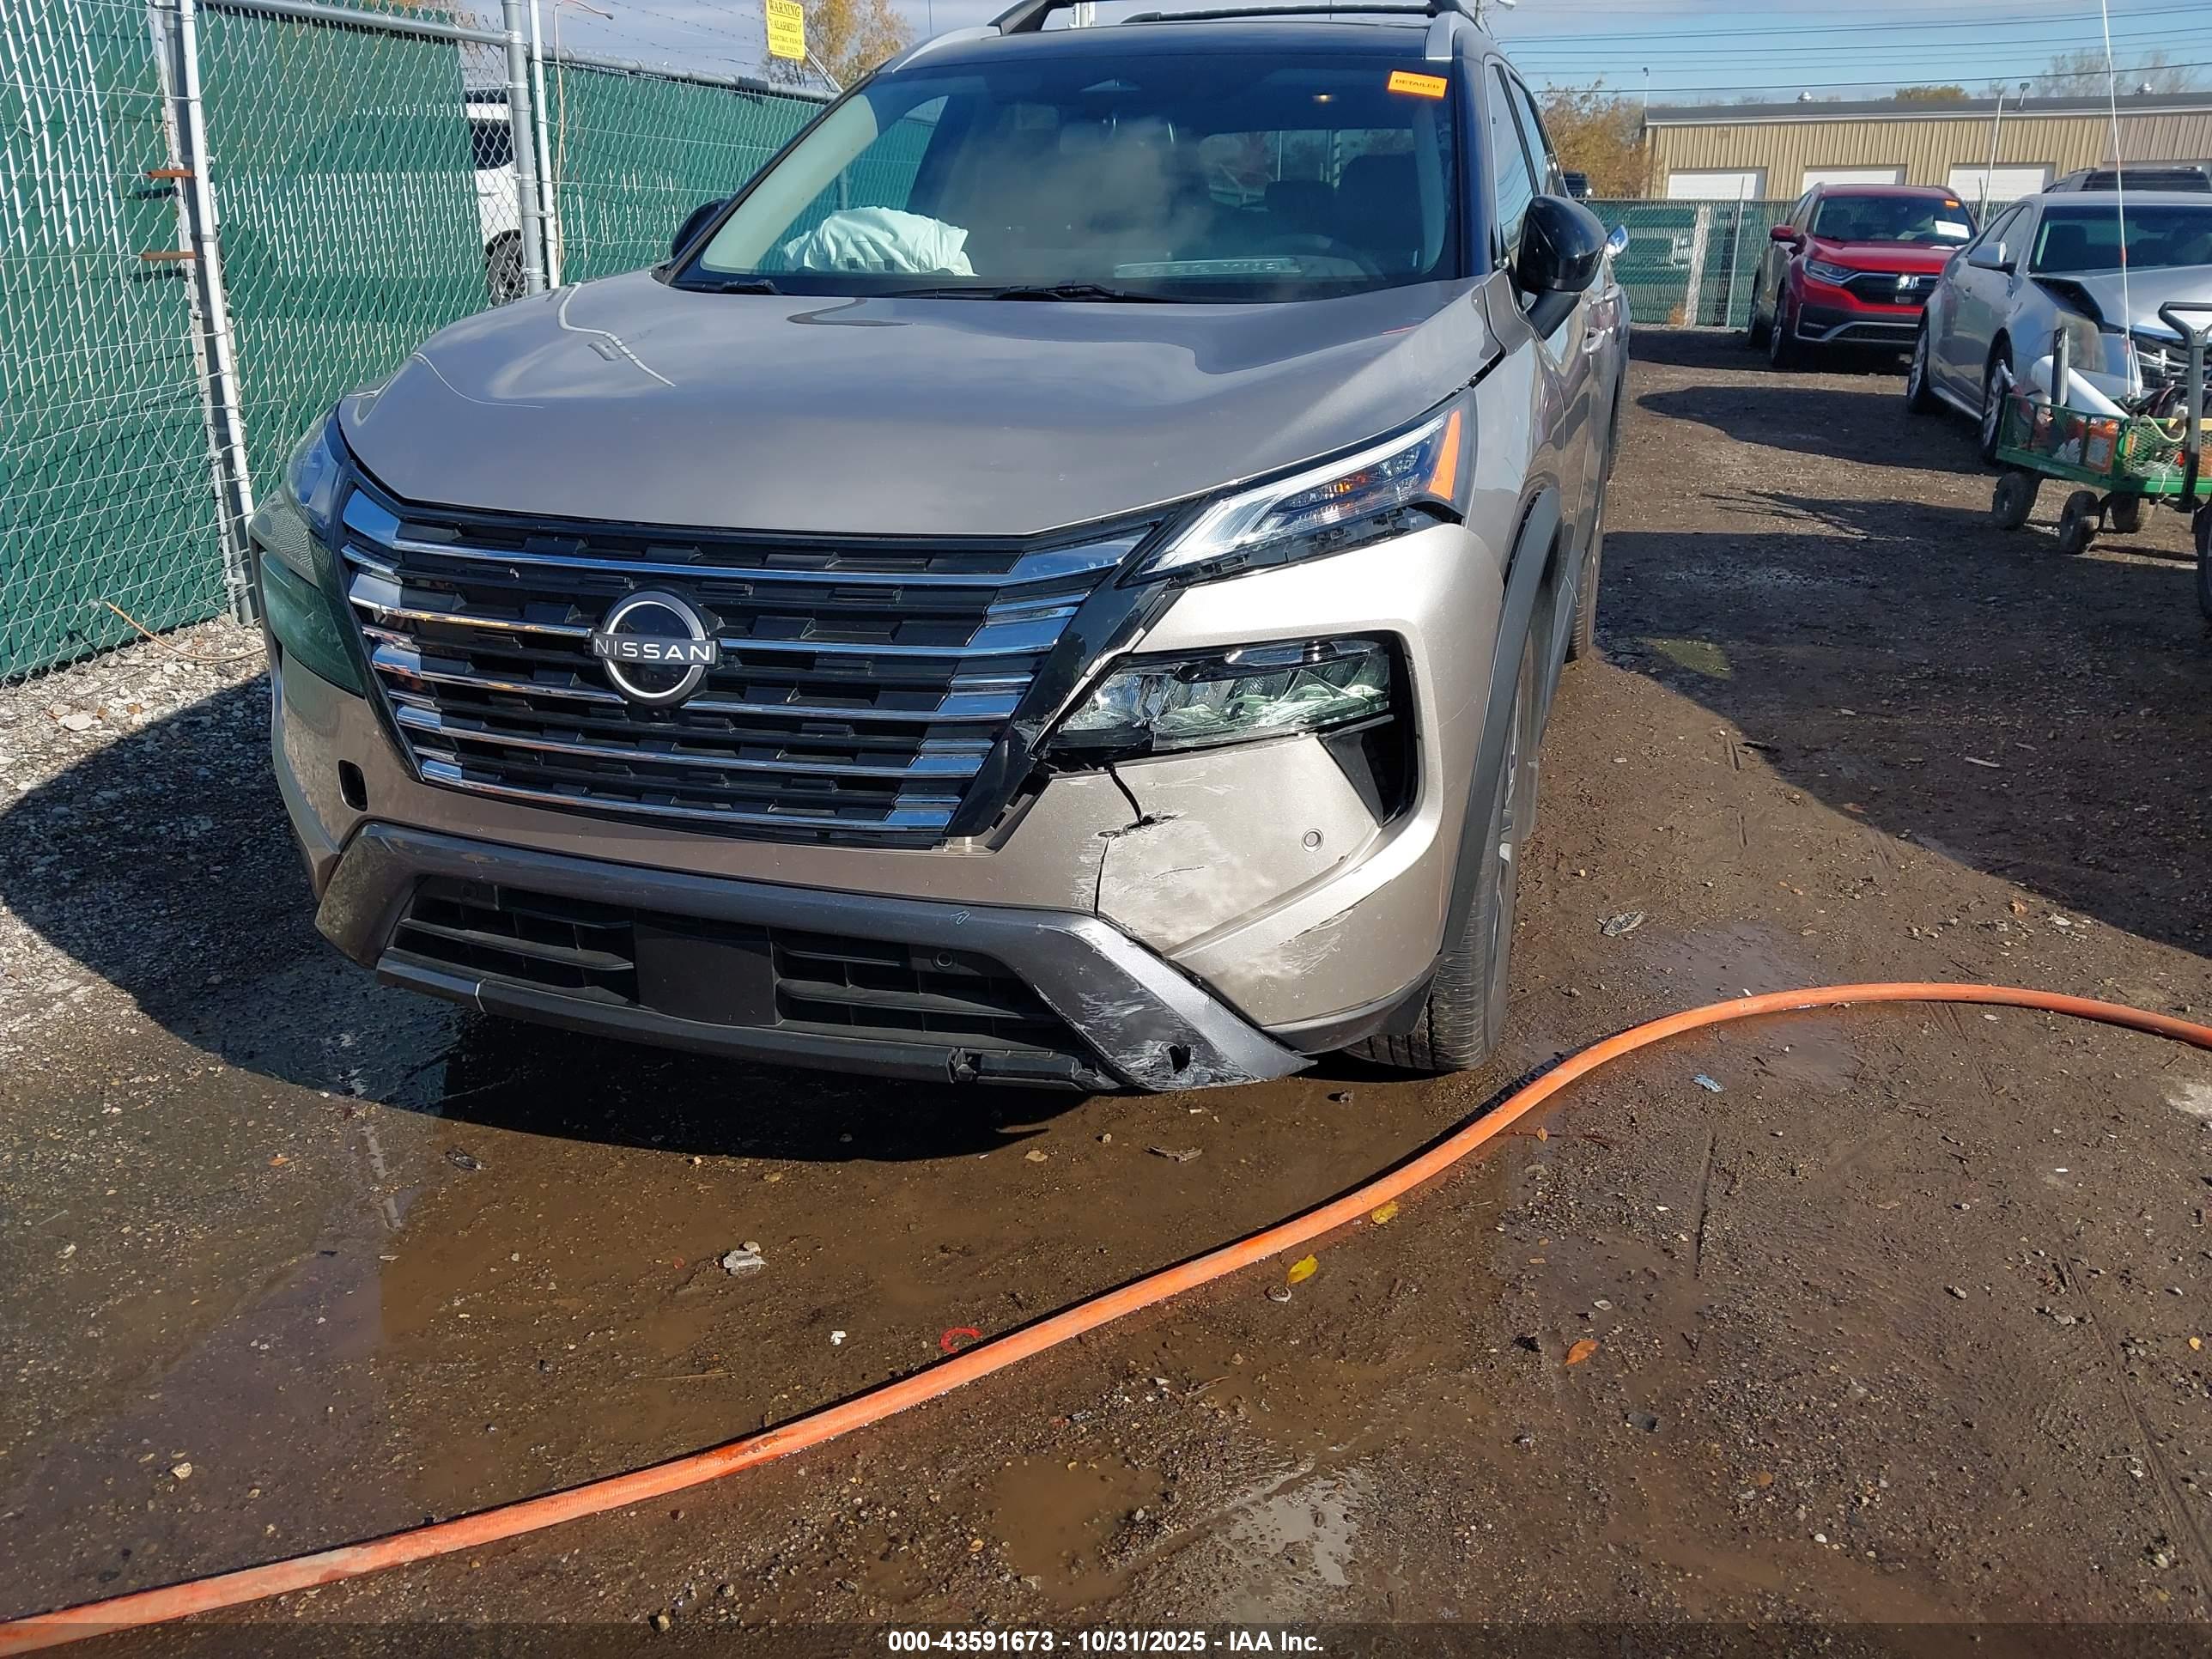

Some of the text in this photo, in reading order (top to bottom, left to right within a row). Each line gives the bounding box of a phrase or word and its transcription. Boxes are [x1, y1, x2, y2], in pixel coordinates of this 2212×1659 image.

[769, 0, 800, 18] WARNING
[769, 33, 802, 46] ELECTRIC FENCE
[1395, 78, 1440, 89] DETAILED
[594, 638, 711, 661] NISSAN
